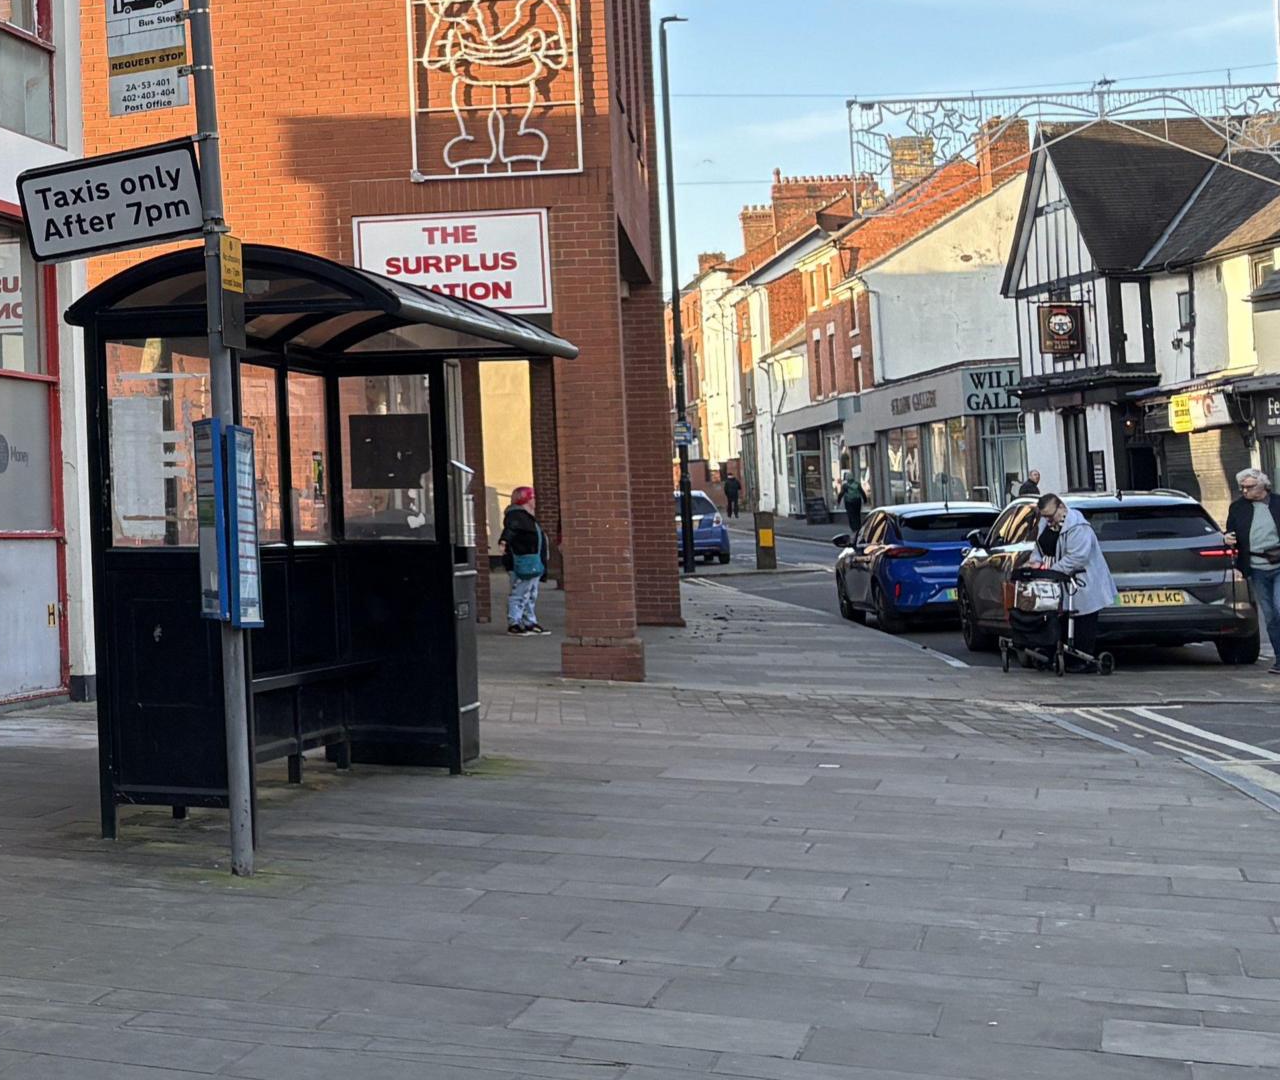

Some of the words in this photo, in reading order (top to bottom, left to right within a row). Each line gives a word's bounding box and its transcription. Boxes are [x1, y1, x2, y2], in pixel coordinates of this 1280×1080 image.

[157, 16, 176, 24] Stop
[112, 57, 156, 71] REQUEST
[159, 52, 183, 62] STOP
[125, 104, 143, 112] Post
[146, 100, 172, 109] Office
[35, 179, 110, 210] Taxis
[121, 166, 180, 195] only
[44, 212, 116, 242] After
[126, 198, 190, 226] 7pm
[422, 225, 477, 244] THE
[386, 252, 517, 275] SURPLUS
[1122, 593, 1153, 604] DV74
[1157, 592, 1181, 602] LKC
